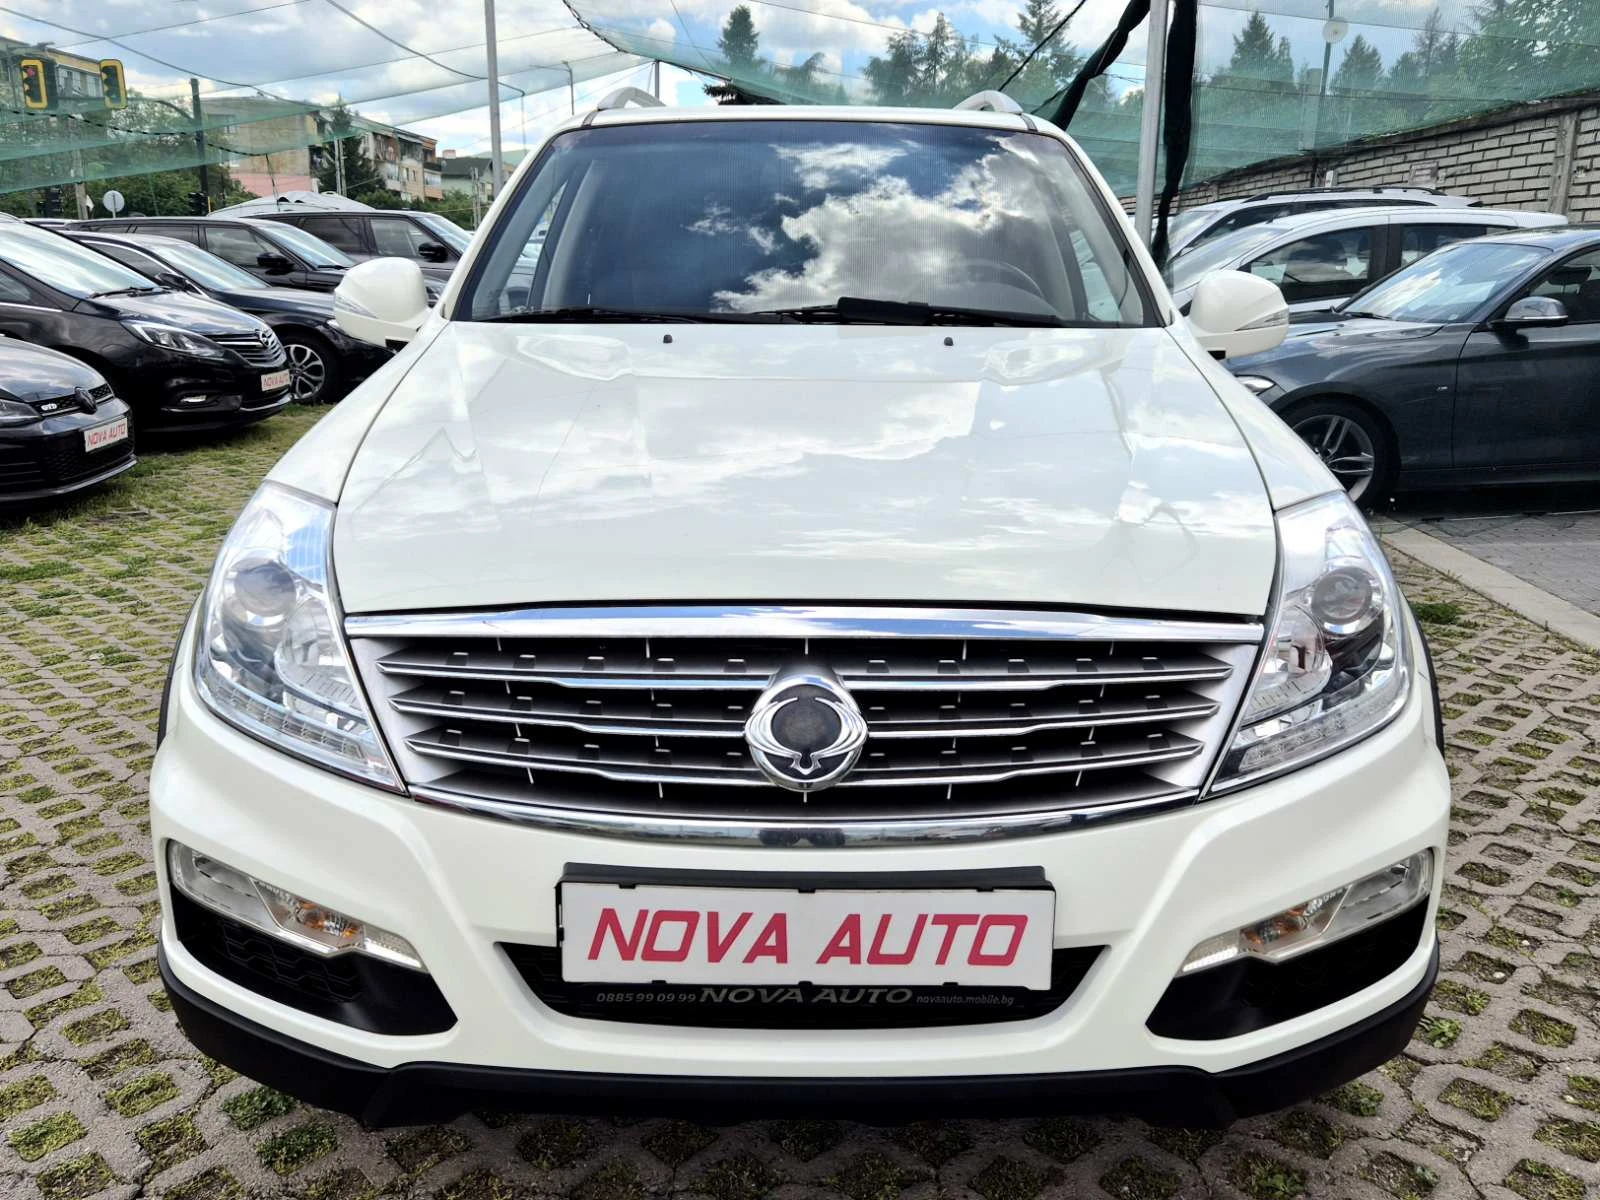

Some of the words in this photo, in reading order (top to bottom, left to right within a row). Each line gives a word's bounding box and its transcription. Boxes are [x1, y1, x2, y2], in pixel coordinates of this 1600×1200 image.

[87, 430, 107, 447] NOVA
[109, 422, 126, 438] AUTO
[588, 908, 788, 964] NOVA
[816, 913, 1028, 967] AUTO
[596, 992, 633, 1003] 0885
[656, 992, 676, 1002] 09
[677, 993, 697, 1003] 99
[700, 987, 803, 1003] NOVA
[811, 988, 913, 1004] AUTO
